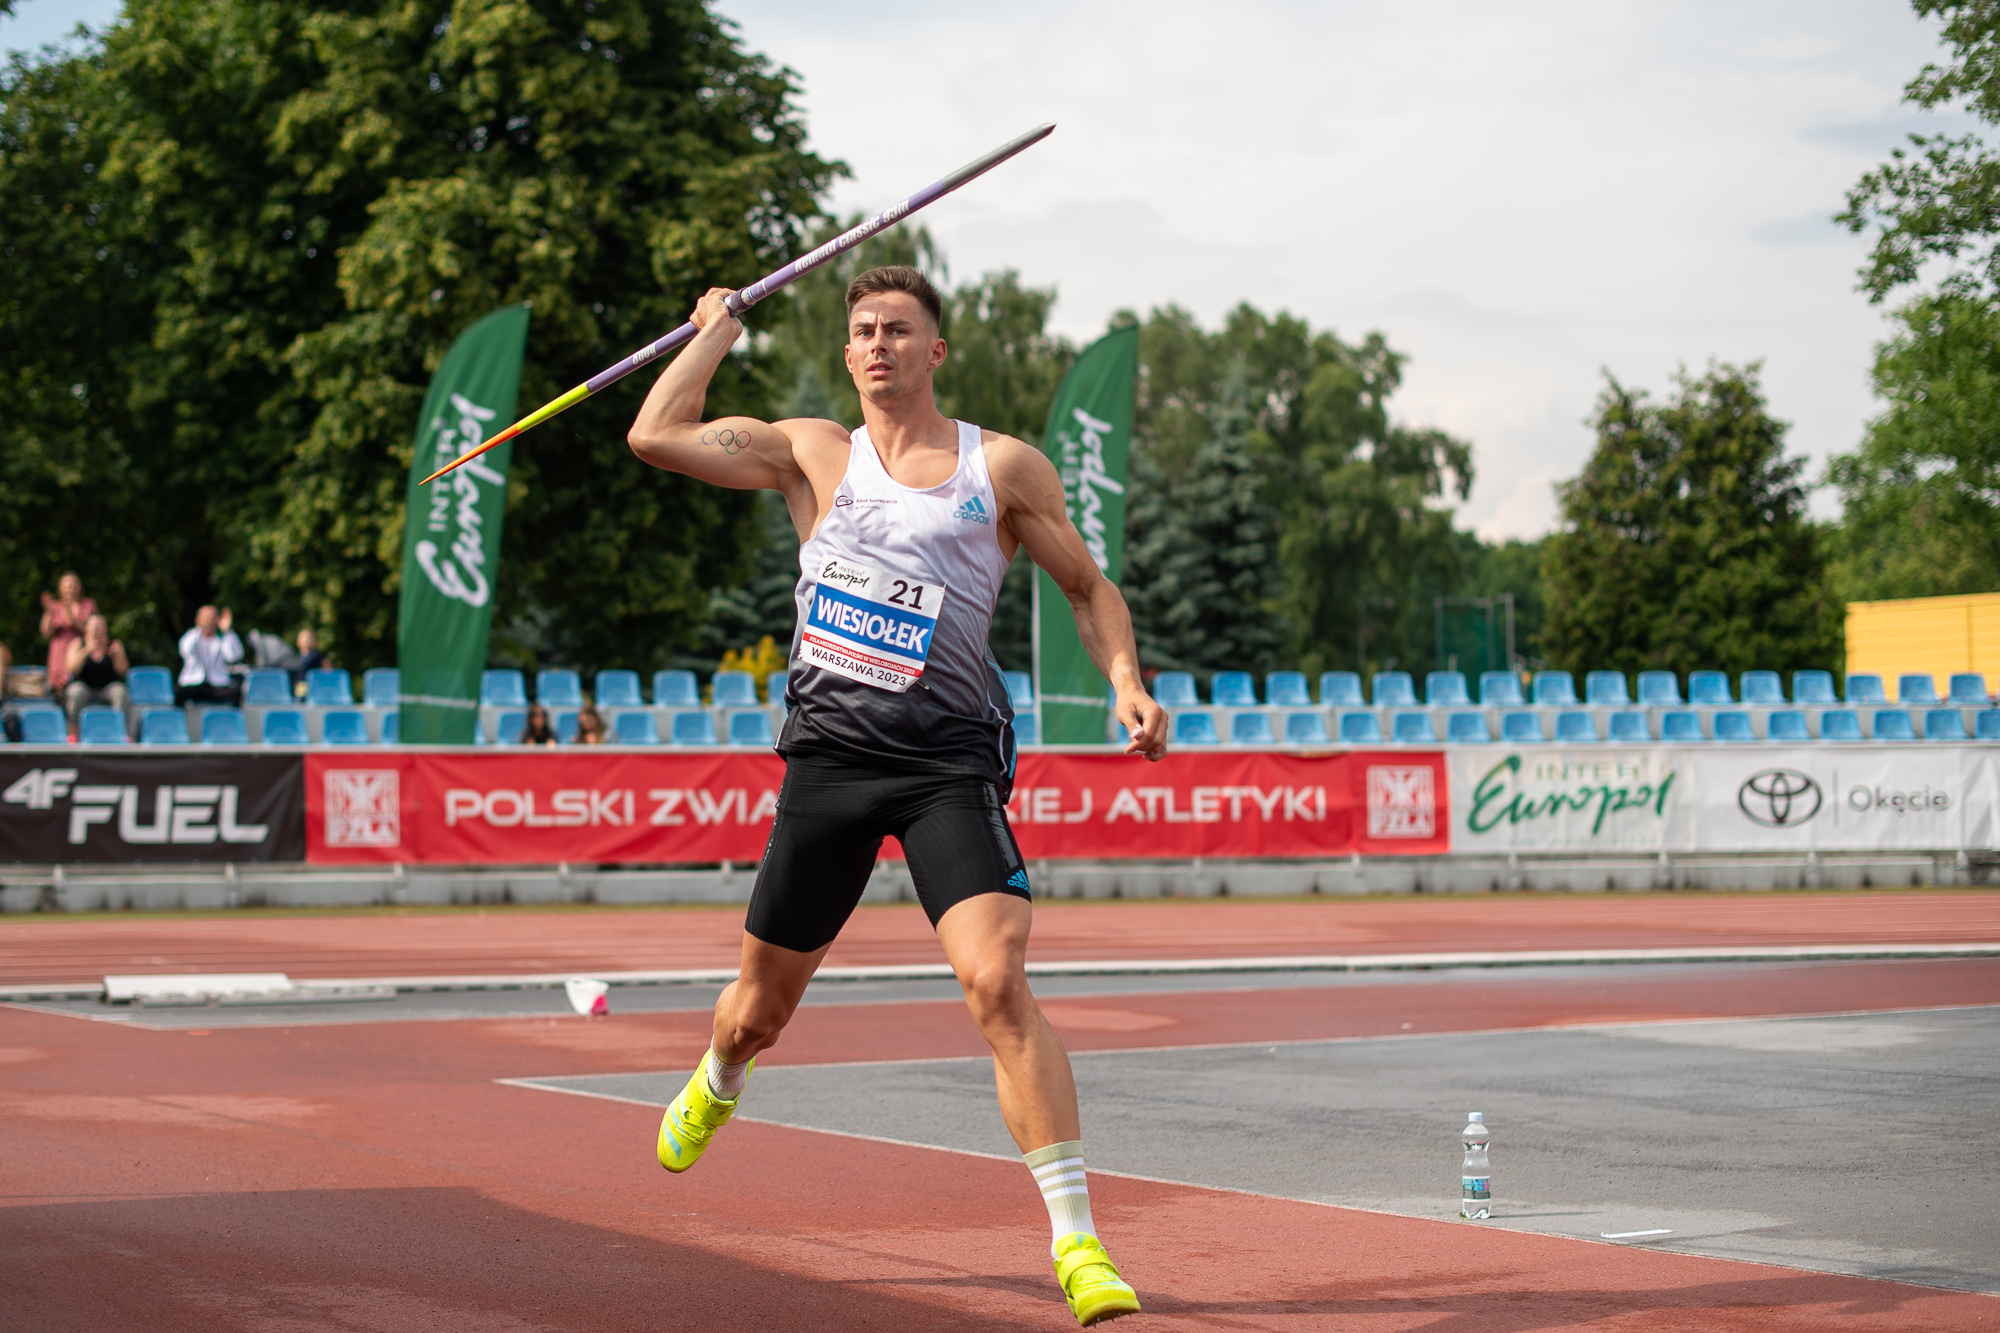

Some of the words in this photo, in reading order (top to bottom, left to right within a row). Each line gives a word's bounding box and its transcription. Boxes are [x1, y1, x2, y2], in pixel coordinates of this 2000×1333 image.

[838, 215, 880, 248] Classic
[415, 392, 506, 608] Europol
[953, 509, 990, 526] adidas
[822, 561, 870, 588] Europol
[838, 565, 863, 577] INTER
[887, 579, 924, 610] 21
[817, 594, 929, 654] WIESIOŁEK
[811, 647, 874, 678] WARSZAWA
[877, 670, 907, 686] 2023
[848, 649, 864, 659] POLSKI
[863, 653, 870, 661] W
[869, 655, 903, 672] WIELOBOJACH
[902, 666, 916, 675] 2023
[1536, 762, 1640, 781] INTER
[2, 767, 79, 810] 4F
[67, 784, 269, 845] FUEL
[445, 788, 635, 828] POLSKI
[1104, 785, 1327, 825] ATLETYKI
[1467, 753, 1677, 836] Europol
[1849, 784, 1950, 818] Okęcie
